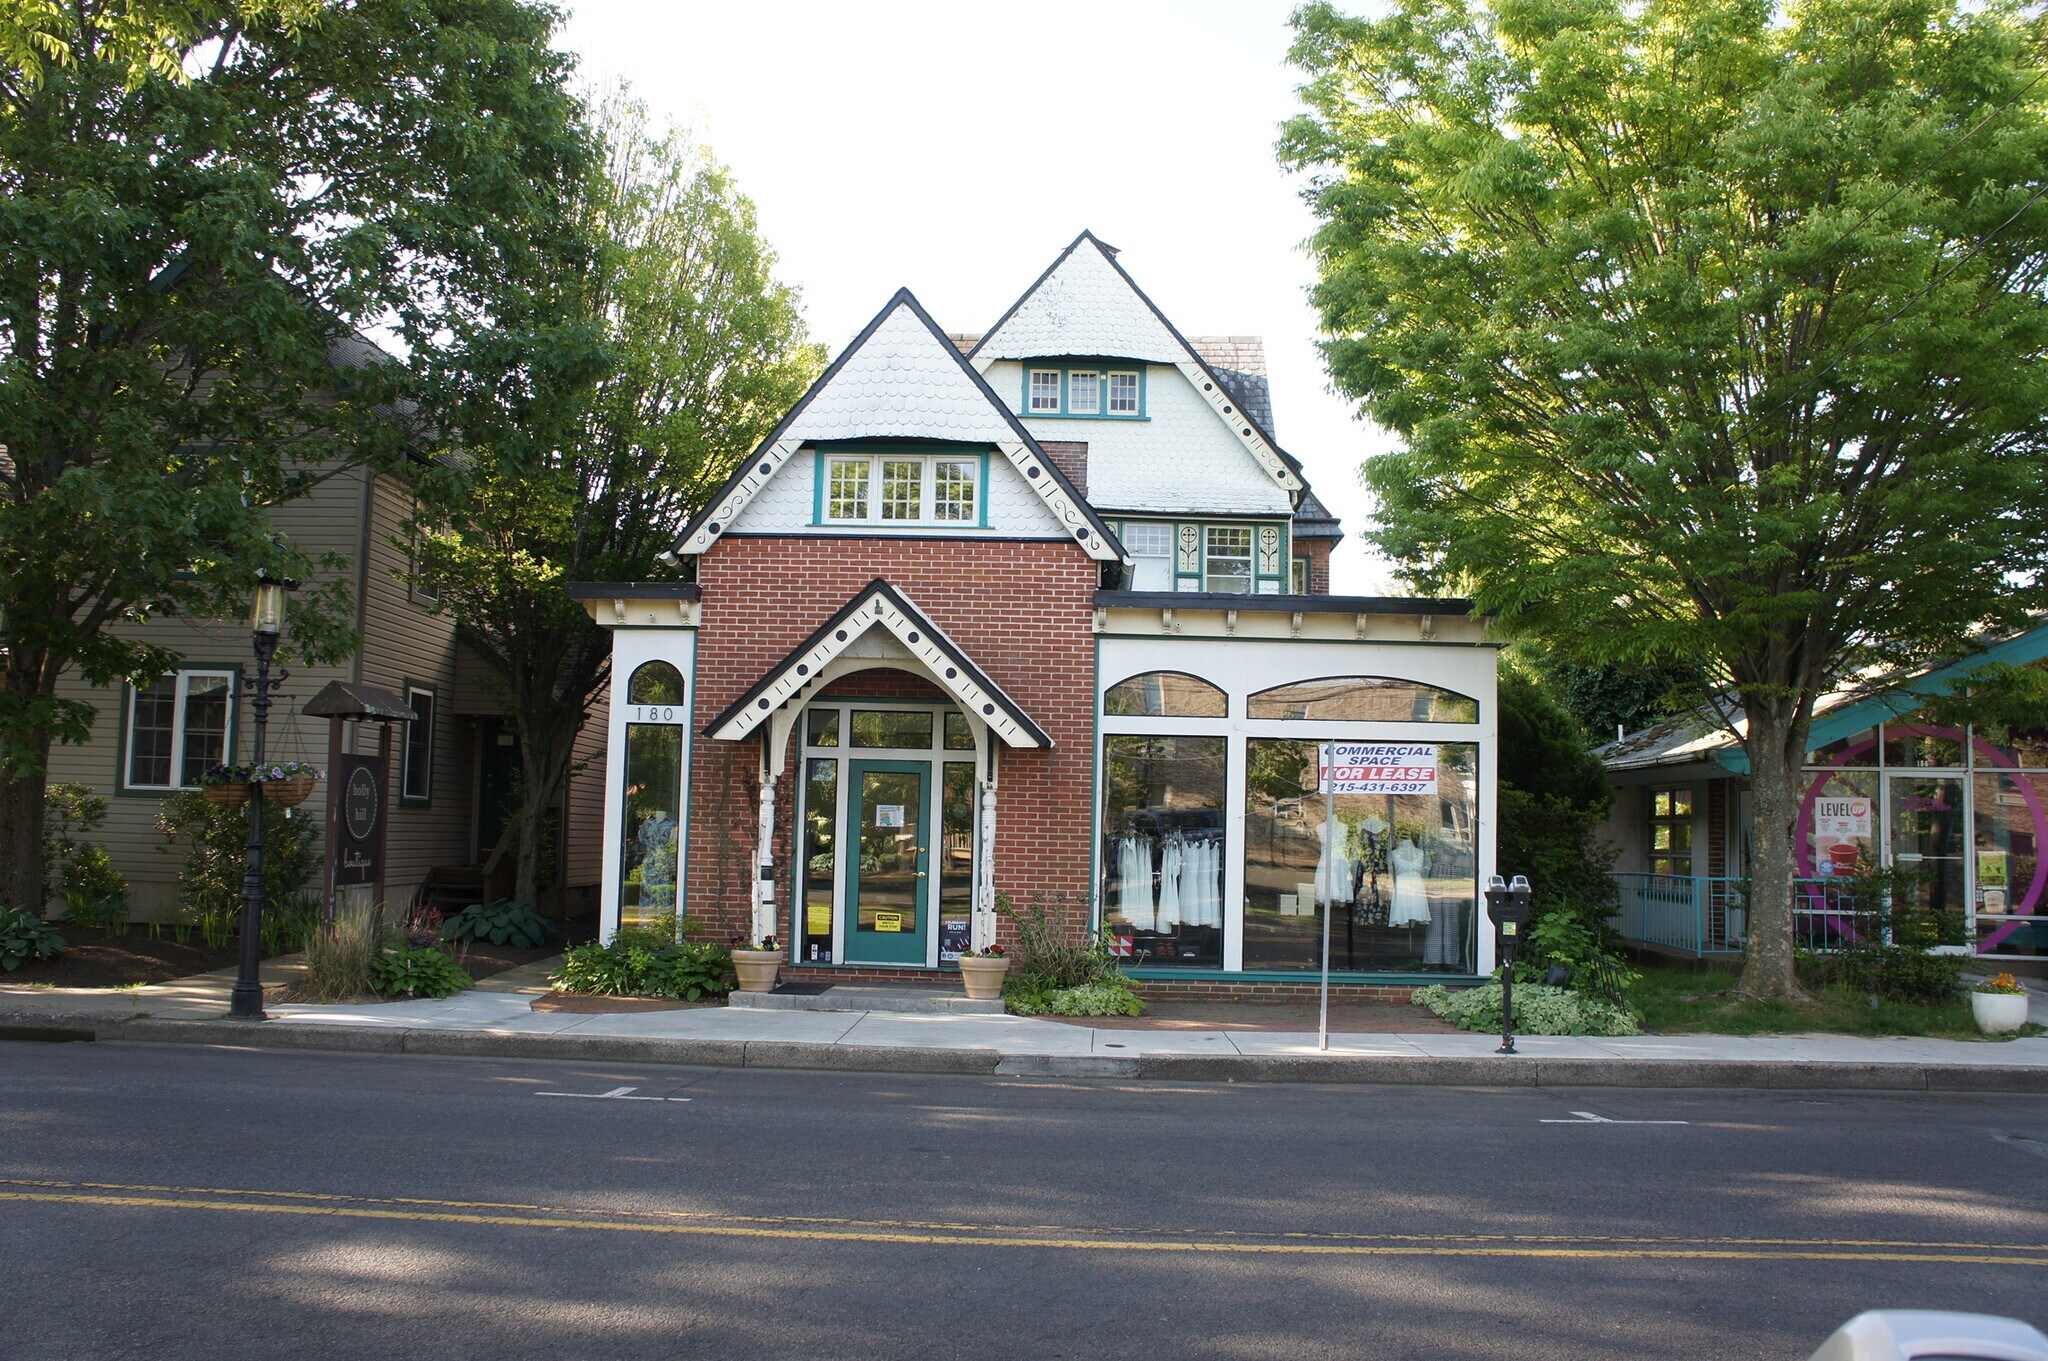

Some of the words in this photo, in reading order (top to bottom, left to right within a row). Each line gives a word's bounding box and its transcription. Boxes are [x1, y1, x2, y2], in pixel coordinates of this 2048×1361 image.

[637, 707, 673, 721] 180
[1348, 756, 1402, 766] SPACE
[1368, 768, 1433, 780] LEASE
[353, 783, 370, 799] holly
[355, 807, 367, 820] hill
[1821, 803, 1851, 816] LEVEL
[1851, 805, 1865, 814] UP
[344, 848, 372, 880] boutique
